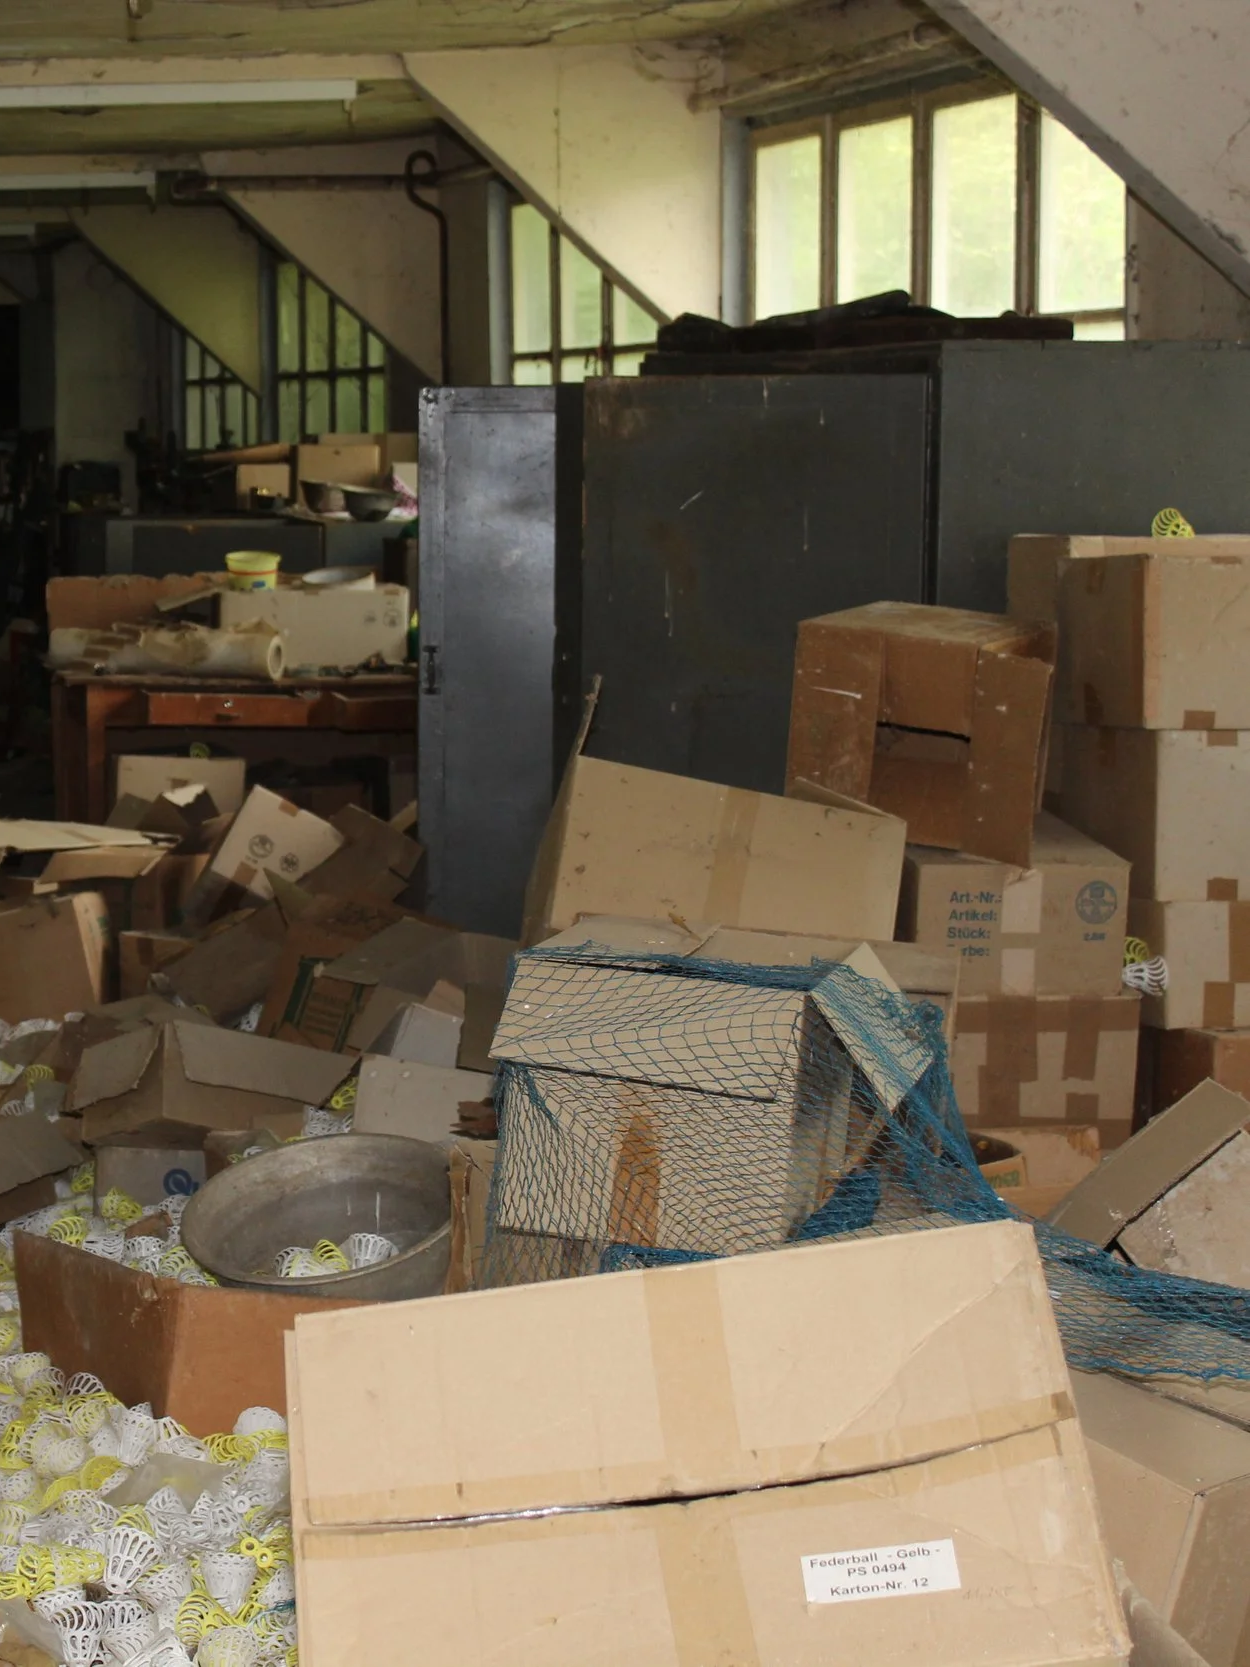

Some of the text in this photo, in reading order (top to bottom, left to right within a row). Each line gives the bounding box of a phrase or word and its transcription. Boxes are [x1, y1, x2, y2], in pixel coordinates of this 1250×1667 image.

[948, 908, 998, 922] Artikel:
[947, 926, 991, 939] Stück:
[809, 1552, 878, 1569] Federball
[896, 1547, 931, 1559] Gelb
[847, 1562, 907, 1577] PS 0494
[830, 1577, 929, 1597] Karton-Nr. 12
